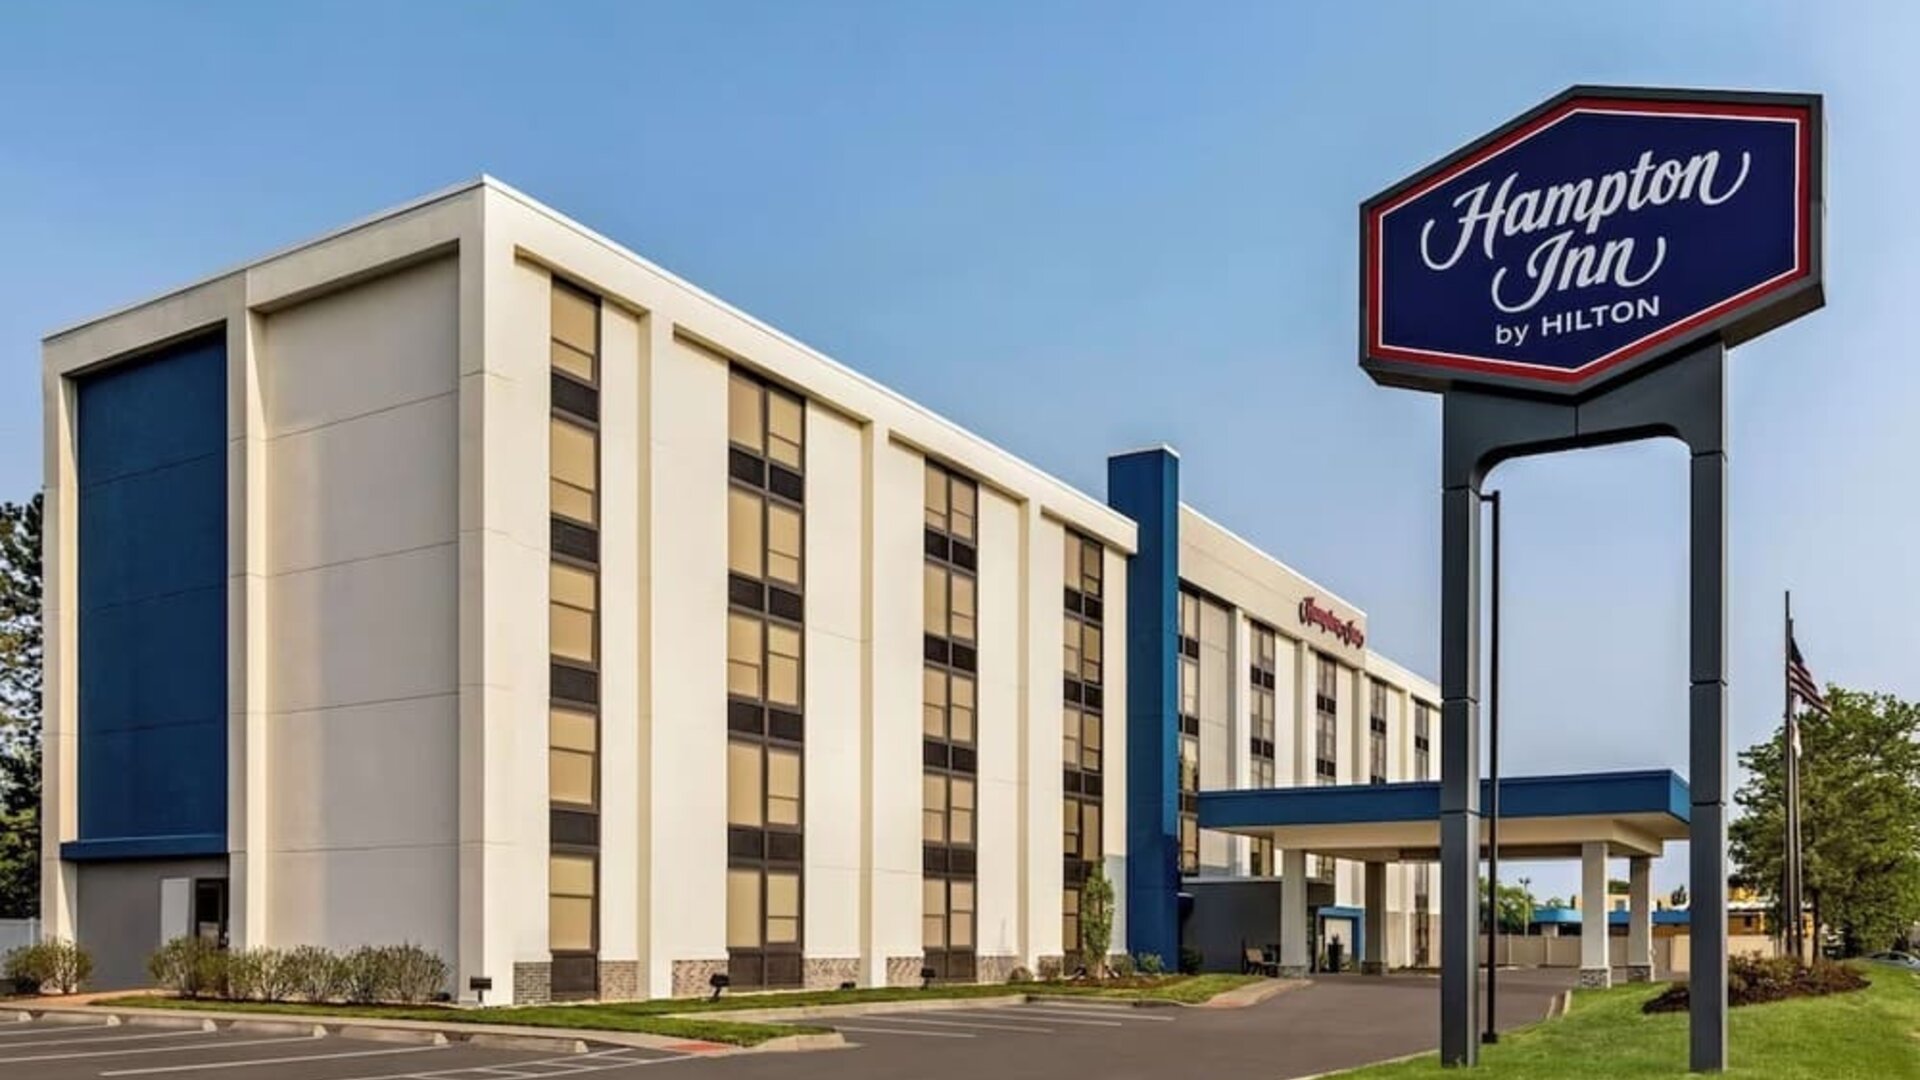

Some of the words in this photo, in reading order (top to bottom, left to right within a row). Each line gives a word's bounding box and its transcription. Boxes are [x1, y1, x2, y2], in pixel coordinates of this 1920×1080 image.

[1420, 149, 1750, 270] Hampton
[1491, 230, 1666, 312] Inn
[1496, 323, 1529, 345] by
[1541, 296, 1660, 336] HILTON
